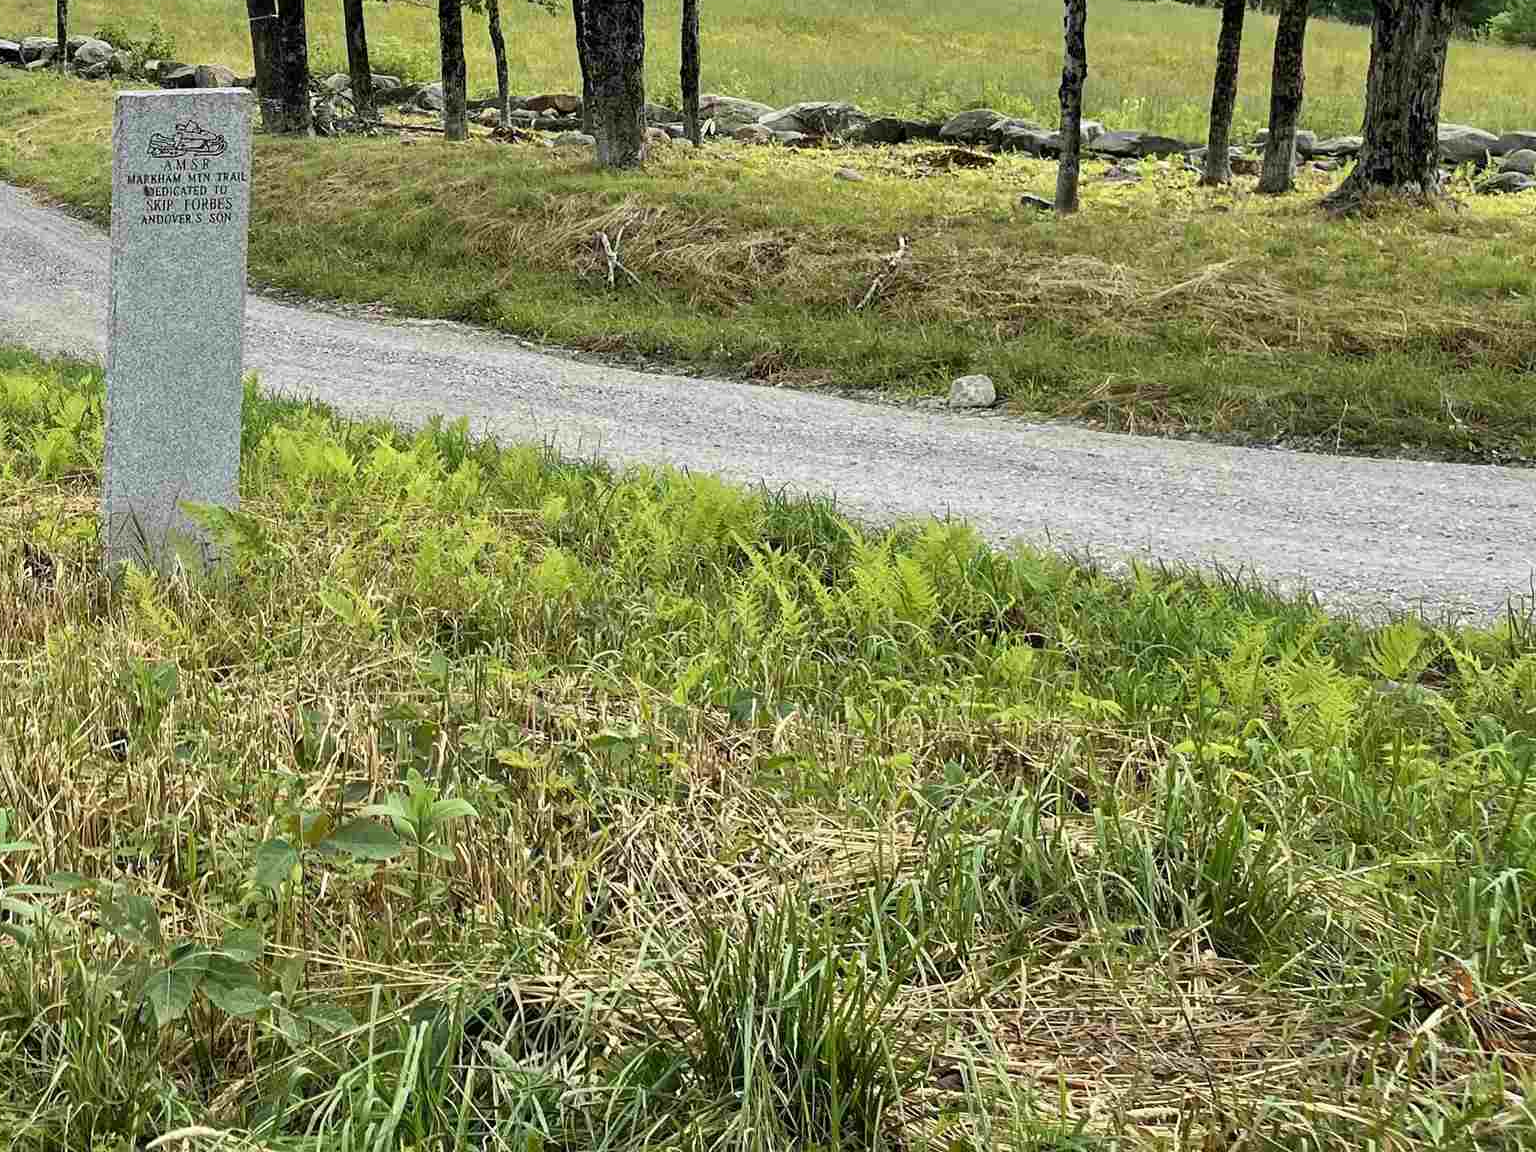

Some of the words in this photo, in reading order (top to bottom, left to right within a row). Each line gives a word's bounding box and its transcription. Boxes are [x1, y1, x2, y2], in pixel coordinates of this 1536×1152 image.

[127, 173, 181, 184] MARKHAM
[216, 171, 246, 182] TRAIL
[145, 185, 207, 197] DEDICATED
[214, 185, 228, 195] TO
[146, 199, 174, 211] SKIP
[184, 198, 233, 210] FORBES
[208, 212, 231, 224] SON
